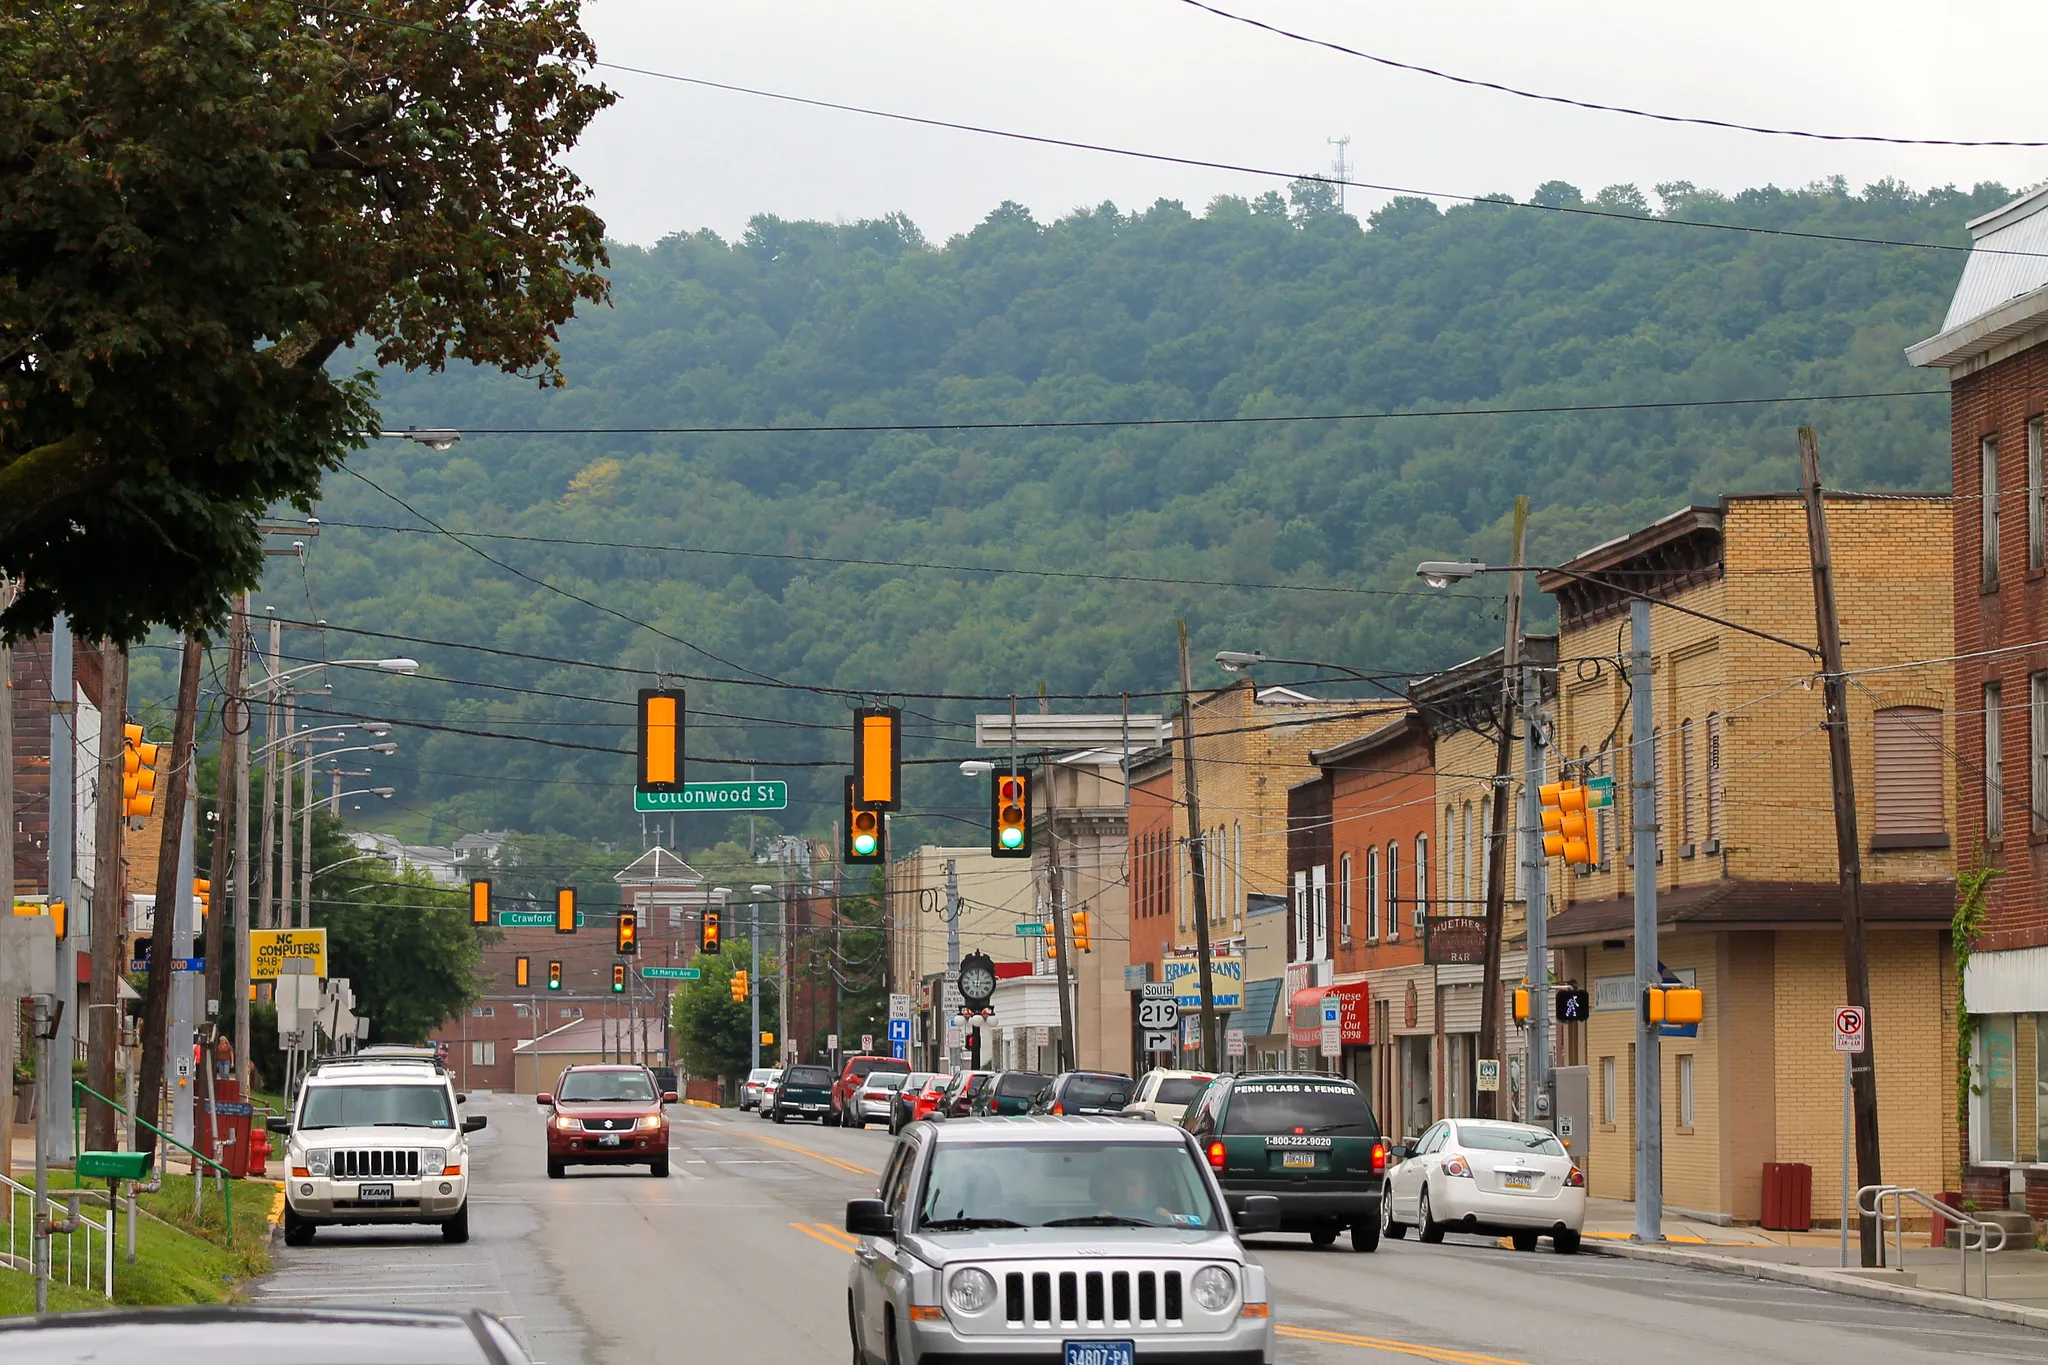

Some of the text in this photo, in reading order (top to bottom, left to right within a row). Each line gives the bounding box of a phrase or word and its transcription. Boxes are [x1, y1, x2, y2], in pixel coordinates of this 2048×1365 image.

[647, 785, 775, 804] Cottonwood St
[511, 914, 552, 923] Crawford
[276, 934, 293, 945] NC
[259, 943, 320, 956] COMPUTERS
[1451, 952, 1471, 962] BAR
[131, 960, 188, 970] COTOOD
[256, 968, 275, 976] NOW
[660, 969, 678, 977] Marys
[1164, 963, 1198, 982] ERMA
[1144, 985, 1173, 996] SOUTH
[1341, 1001, 1356, 1011] od
[1141, 1005, 1175, 1022] 219
[1346, 1011, 1356, 1021] In
[1344, 1020, 1361, 1030] Out
[1234, 1084, 1356, 1096] PENN GLASS & FENDER
[1264, 1136, 1332, 1147] 1-800-222-9020
[362, 1188, 391, 1196] TEAM
[1069, 1349, 1130, 1365] 34807-PA
